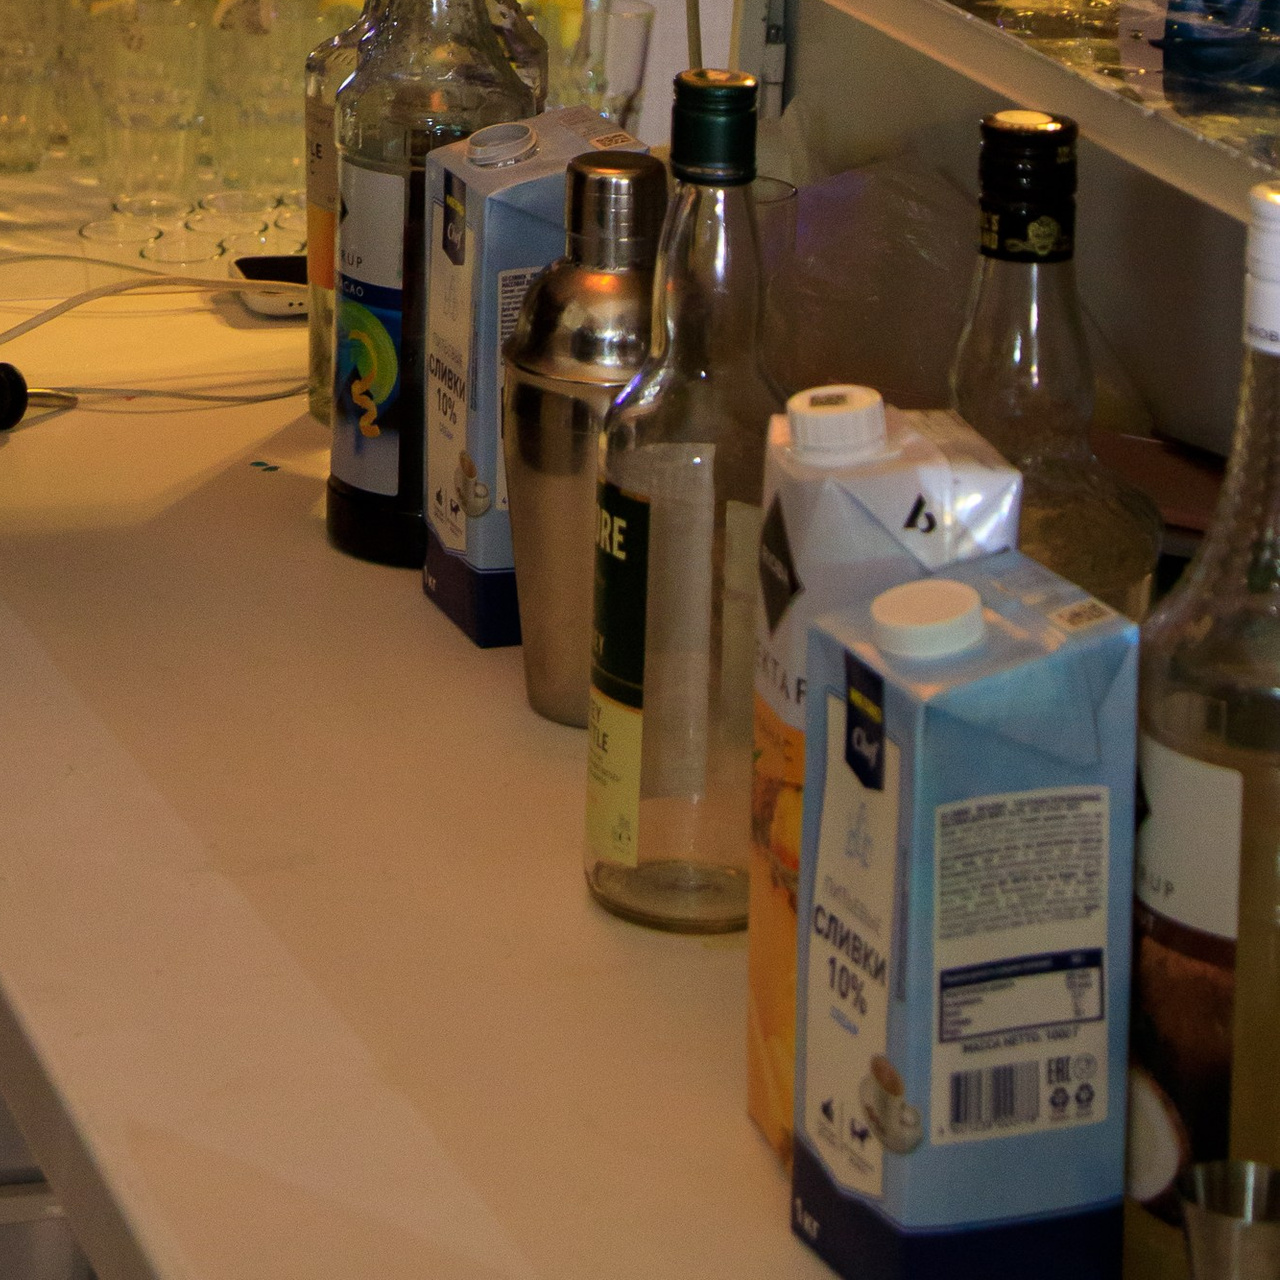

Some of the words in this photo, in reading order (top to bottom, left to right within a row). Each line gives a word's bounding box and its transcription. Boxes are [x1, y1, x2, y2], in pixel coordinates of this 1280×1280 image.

[428, 353, 466, 403] СЛИВКИ
[436, 387, 457, 426] 10%
[813, 903, 887, 988] СЛИВКИ
[827, 955, 868, 1017] 10%
